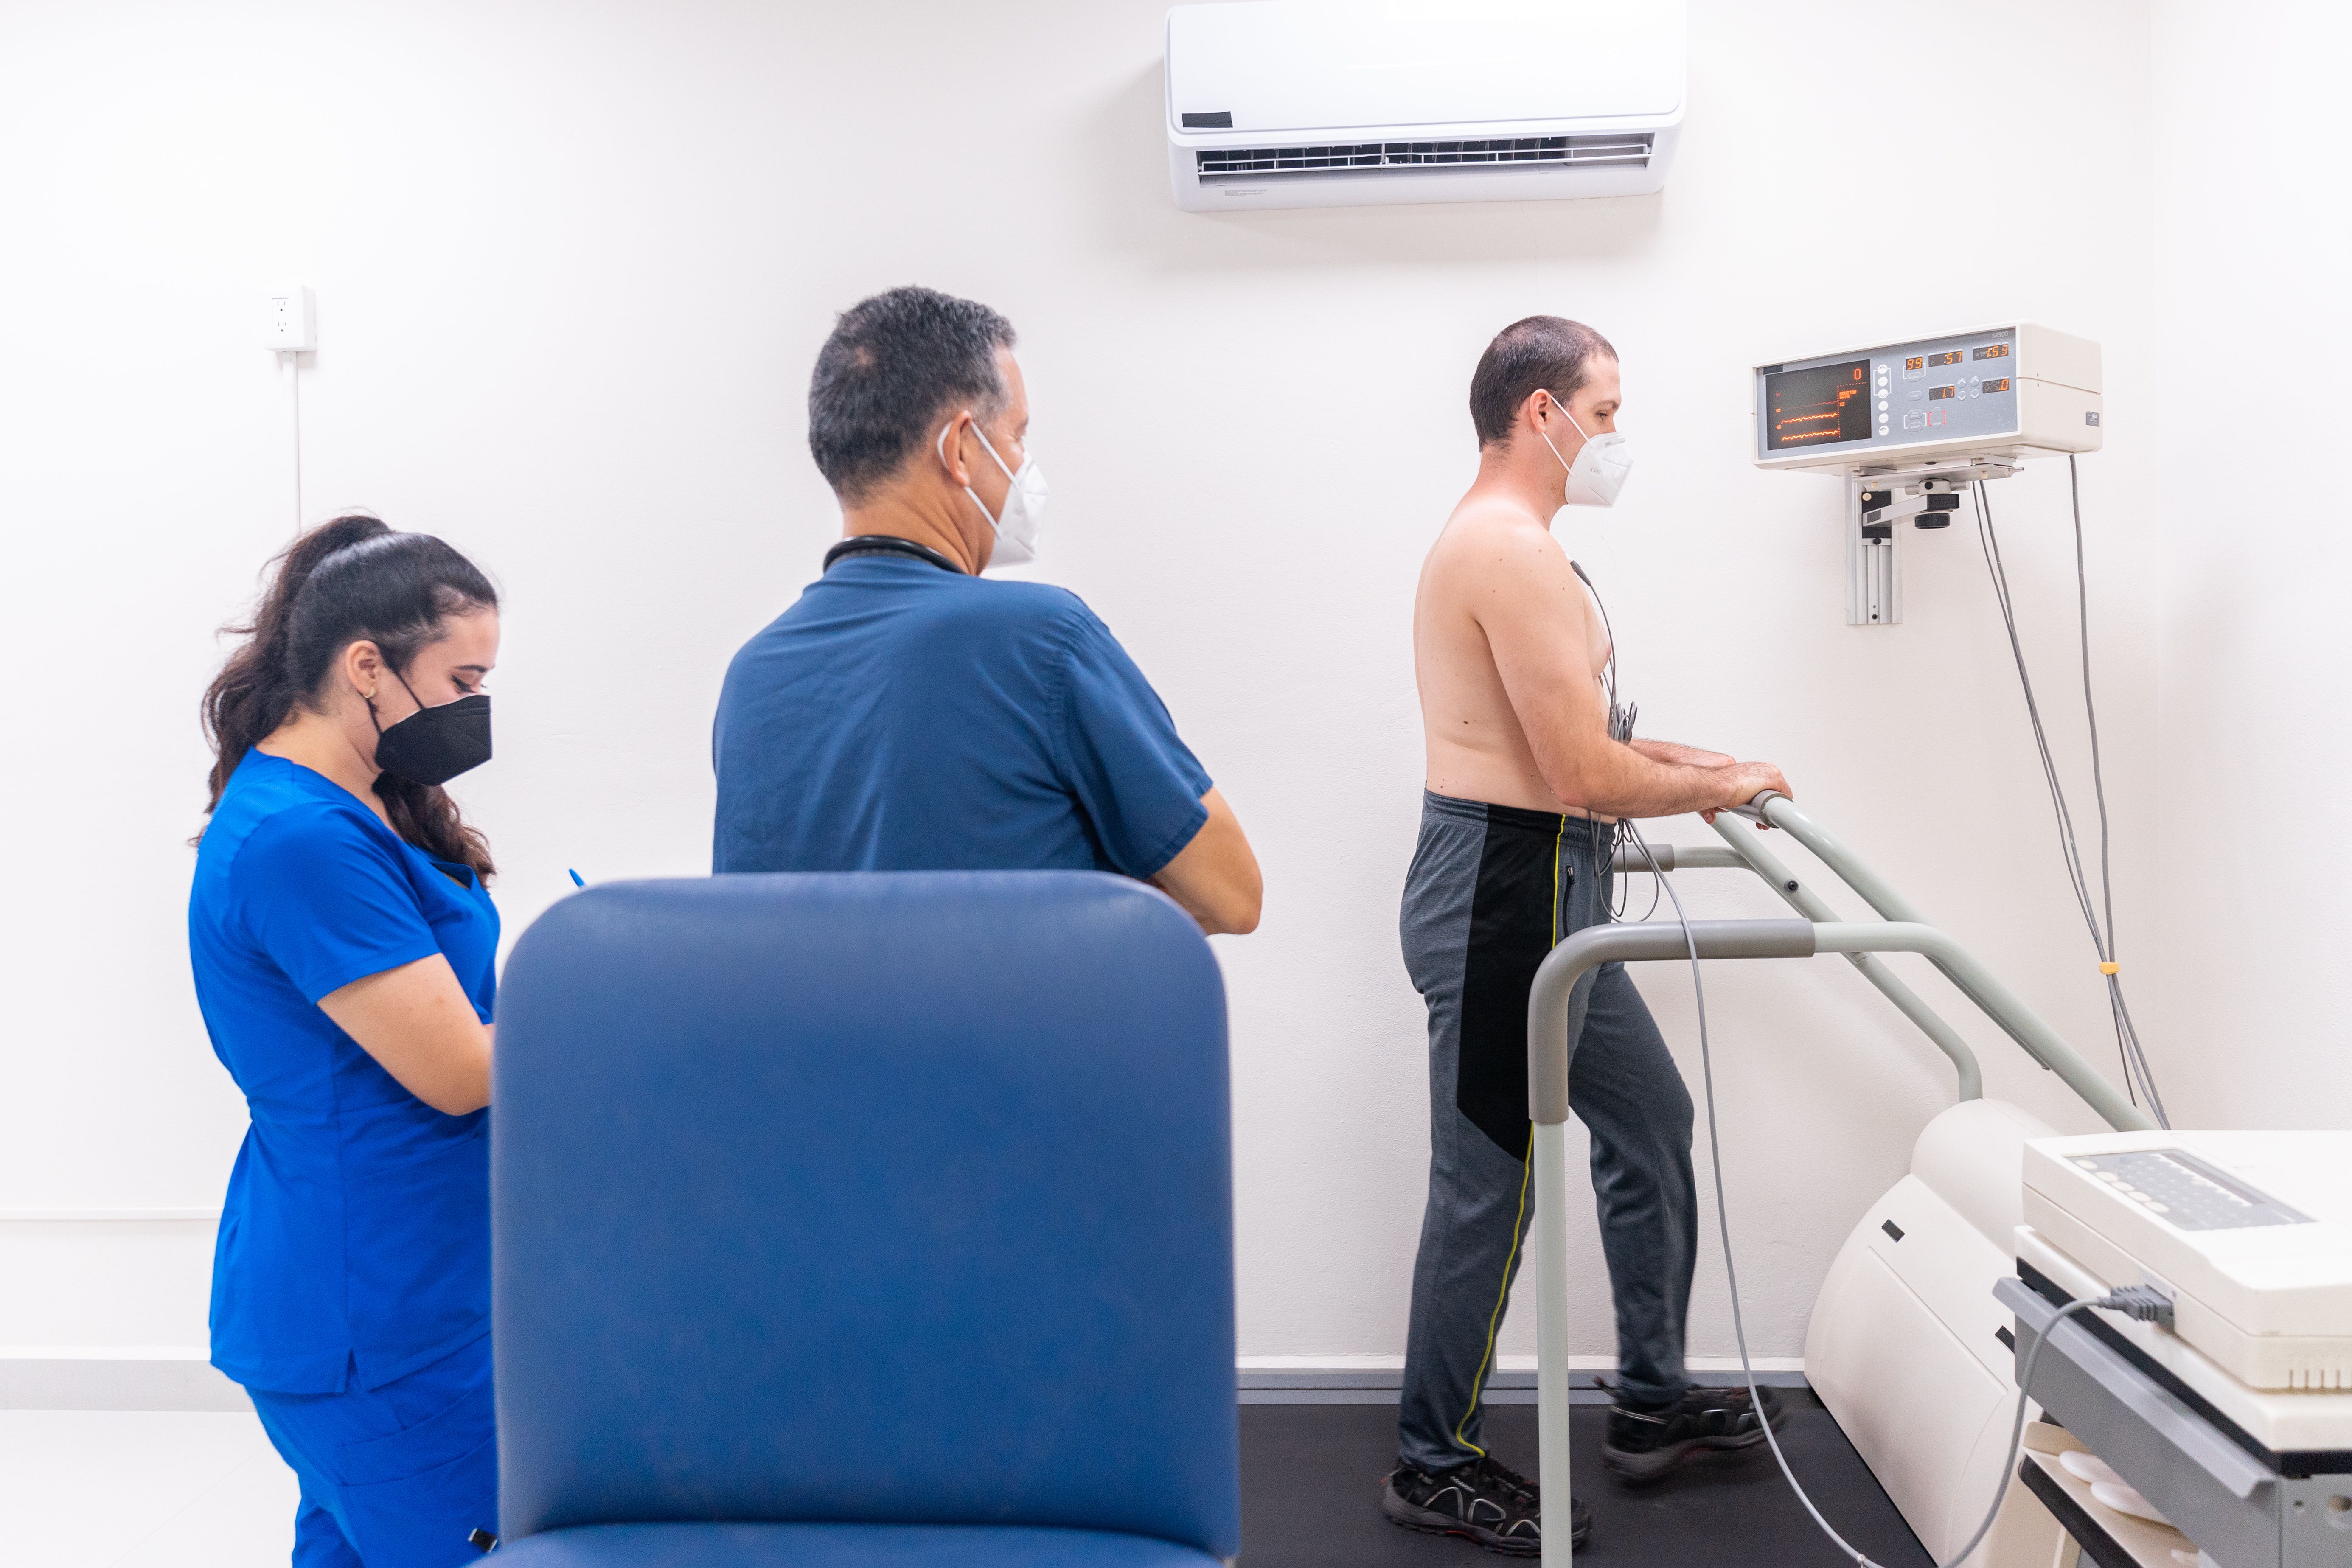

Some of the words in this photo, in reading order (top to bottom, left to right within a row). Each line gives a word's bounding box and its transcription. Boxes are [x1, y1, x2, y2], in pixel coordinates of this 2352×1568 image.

[1907, 357, 1922, 370] 99
[1854, 368, 1861, 380] 0
[1589, 467, 1601, 475] KN95
